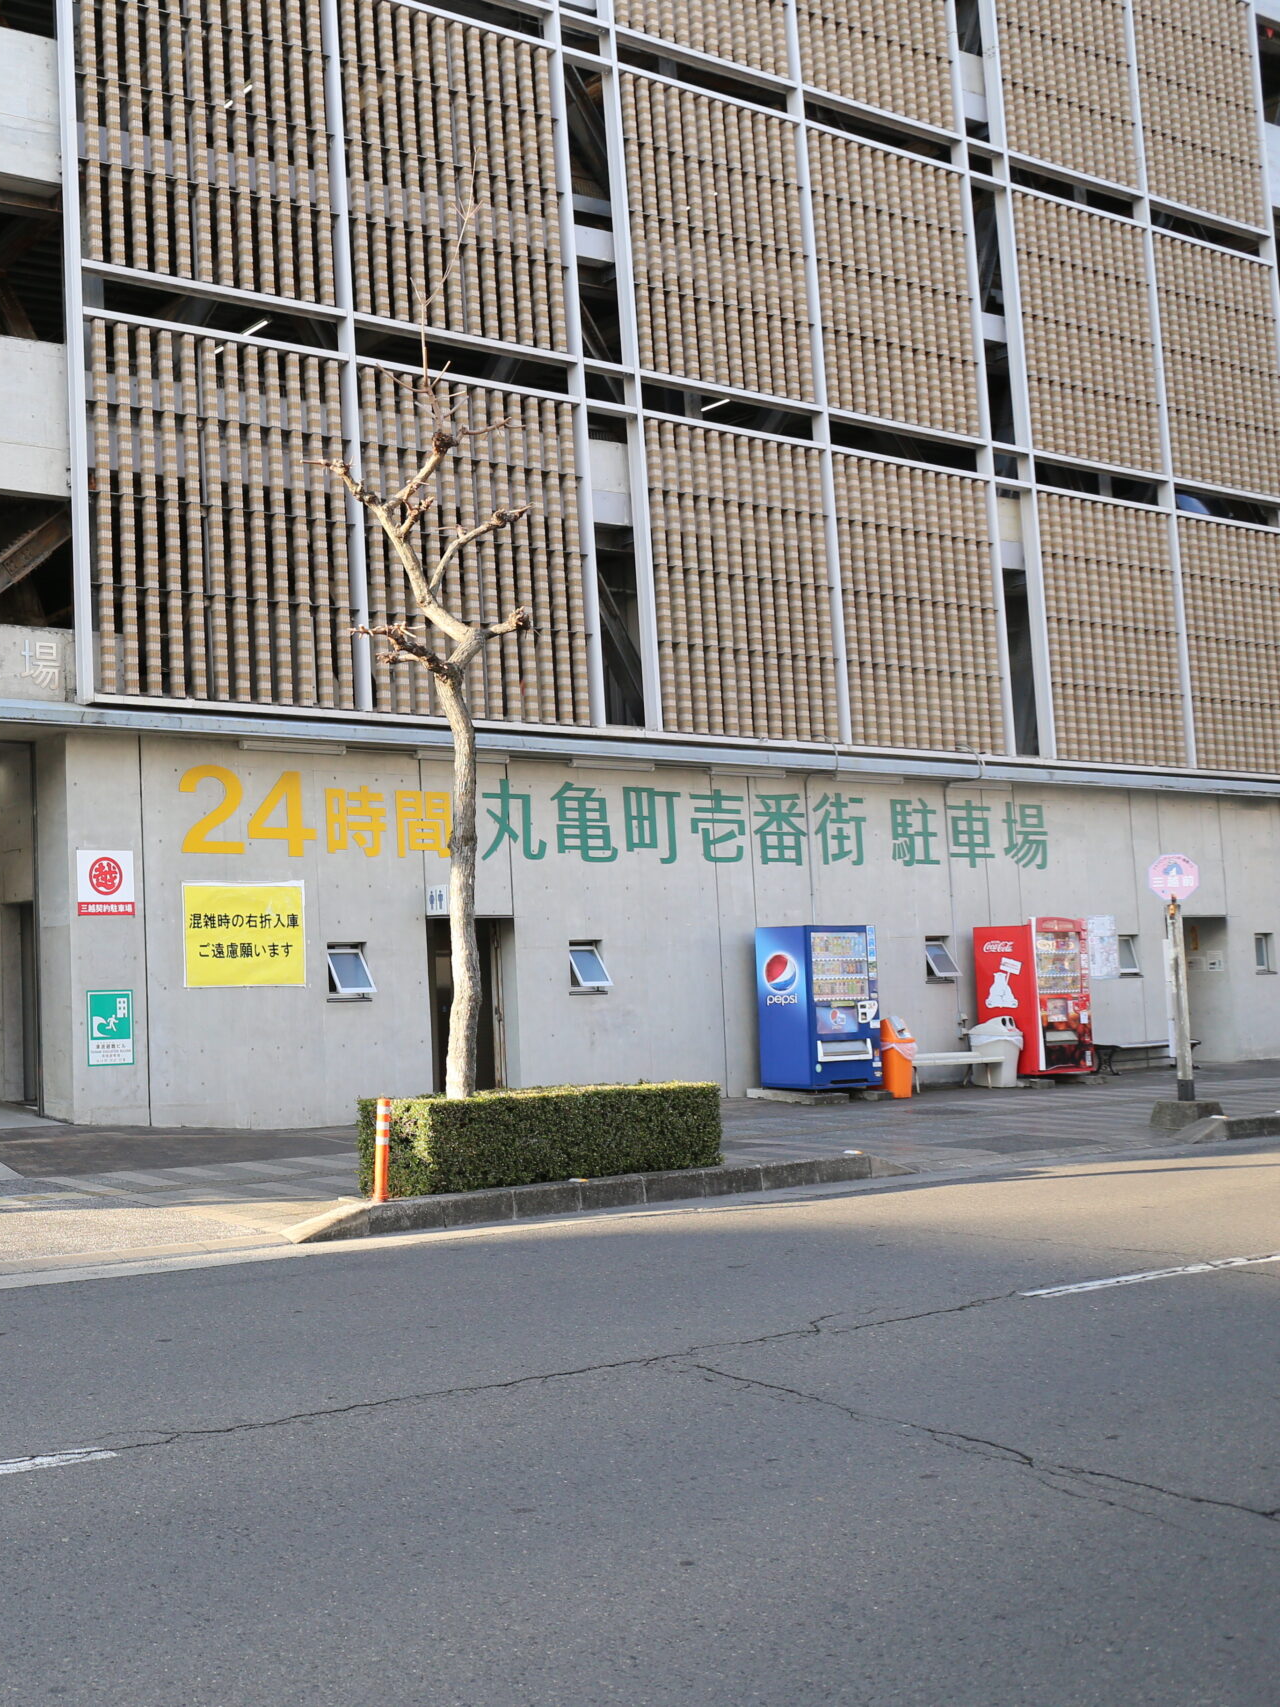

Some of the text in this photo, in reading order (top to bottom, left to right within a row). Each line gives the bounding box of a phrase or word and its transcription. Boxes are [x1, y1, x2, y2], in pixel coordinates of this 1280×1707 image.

[178, 764, 453, 858] 24時間
[189, 912, 300, 930] 混雑時の右折入庫
[198, 941, 293, 959] ご遠慮願います
[983, 940, 1015, 953] Coca-Cola
[766, 993, 798, 1006] pepsi
